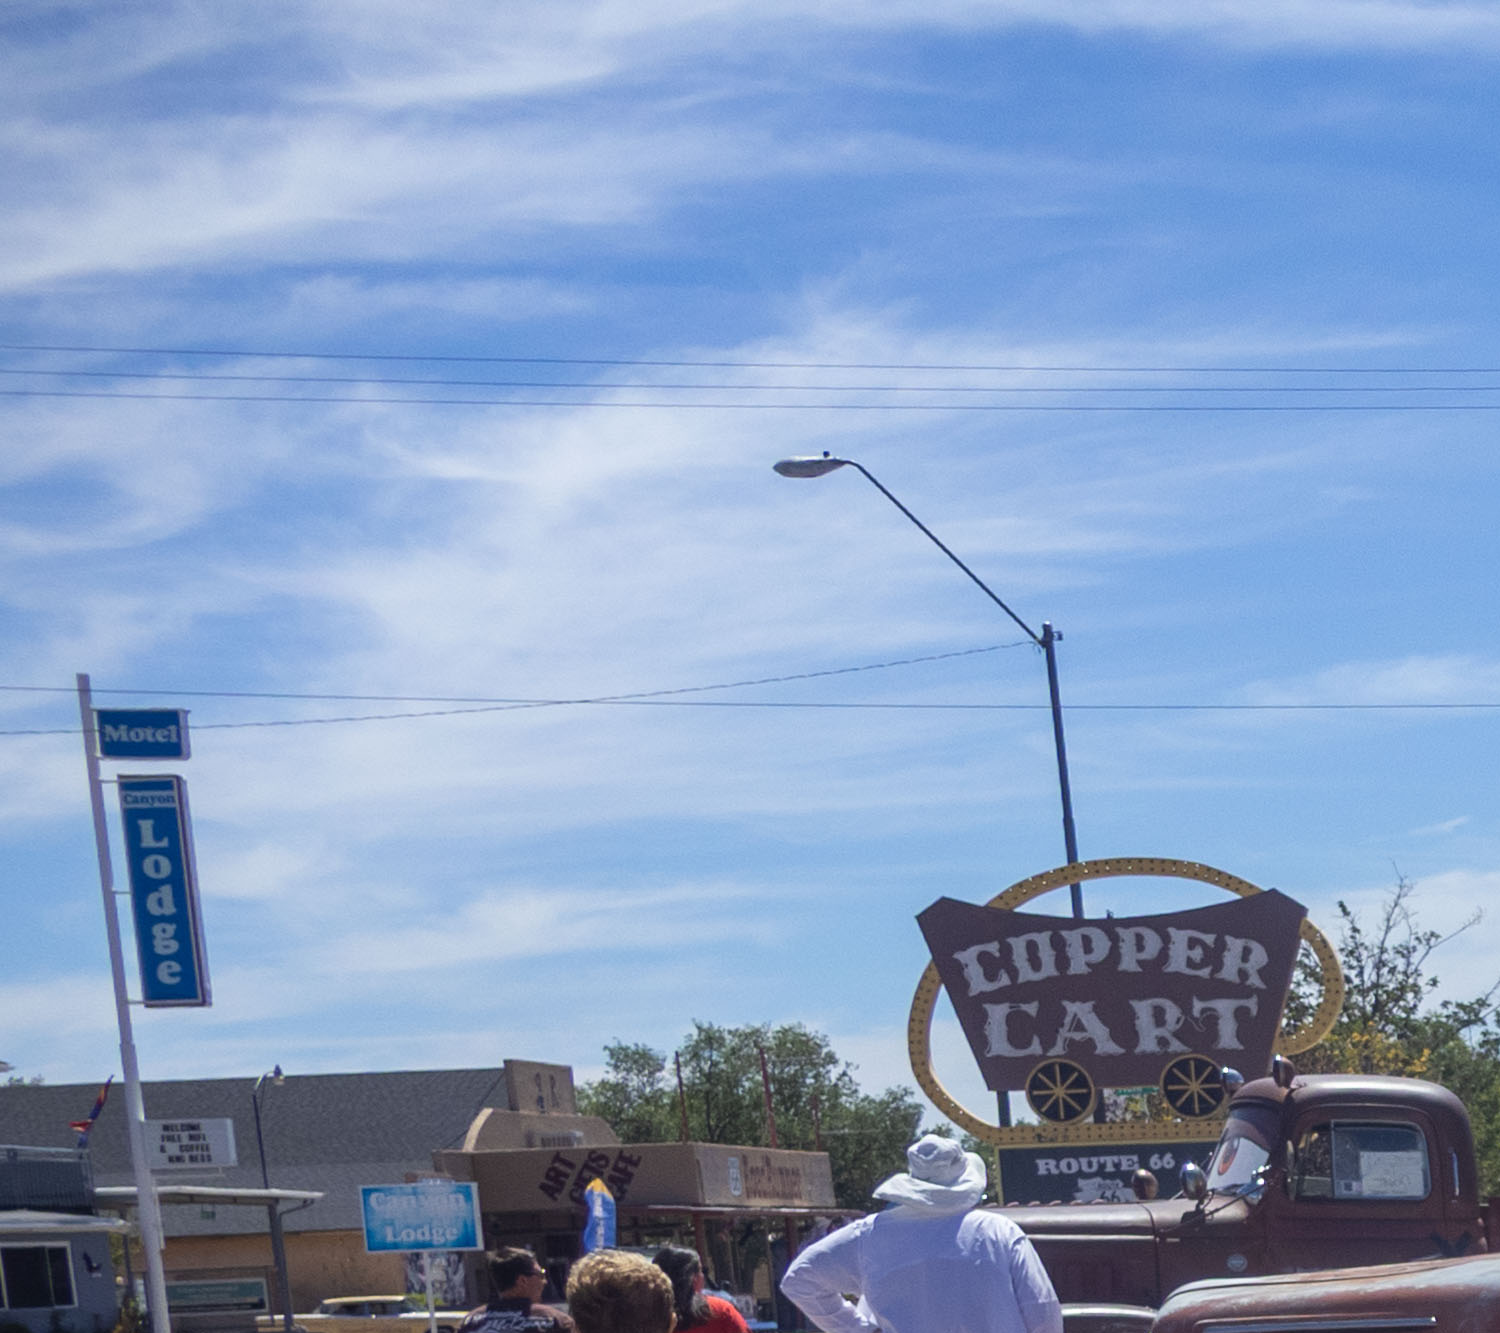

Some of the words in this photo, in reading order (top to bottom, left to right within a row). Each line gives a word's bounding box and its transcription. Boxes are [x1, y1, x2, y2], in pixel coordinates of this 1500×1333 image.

[103, 723, 178, 744] Motel
[123, 792, 176, 807] Canyon
[137, 818, 182, 985] Lodge
[952, 926, 1269, 997] COPPER
[982, 996, 1259, 1058] CART
[1035, 1155, 1139, 1176] ROUTE
[1149, 1152, 1176, 1170] 66
[384, 1223, 459, 1246] Lodge
